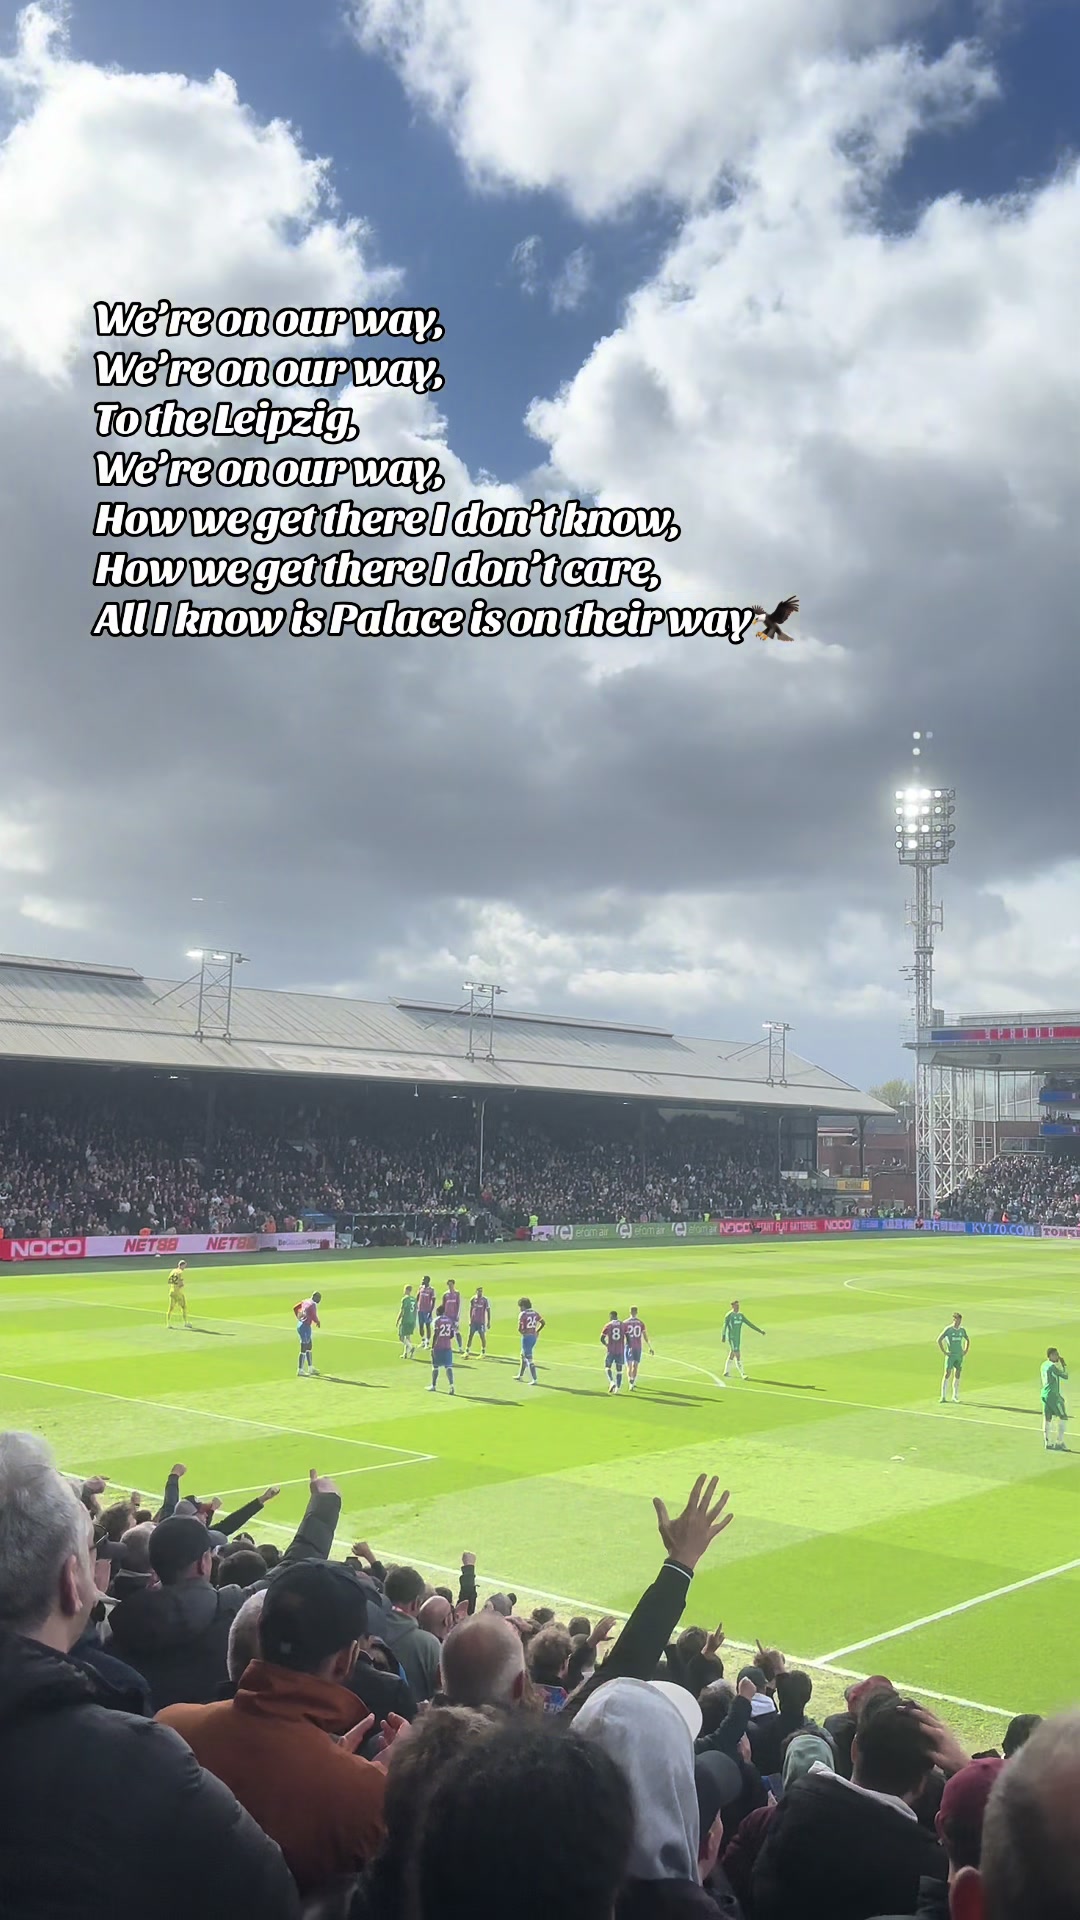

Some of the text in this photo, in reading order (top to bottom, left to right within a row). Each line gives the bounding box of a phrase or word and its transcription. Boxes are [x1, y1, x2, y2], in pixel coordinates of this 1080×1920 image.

[720, 1222, 750, 1232] NOCO
[824, 1220, 851, 1231] NOCO
[972, 1222, 1035, 1235] KY170.COM
[11, 1240, 82, 1257] NOCO
[124, 1238, 179, 1252] NET88
[527, 1316, 537, 1329] 26
[440, 1324, 451, 1336] 23
[612, 1328, 620, 1340] 8
[629, 1325, 641, 1337] 20
